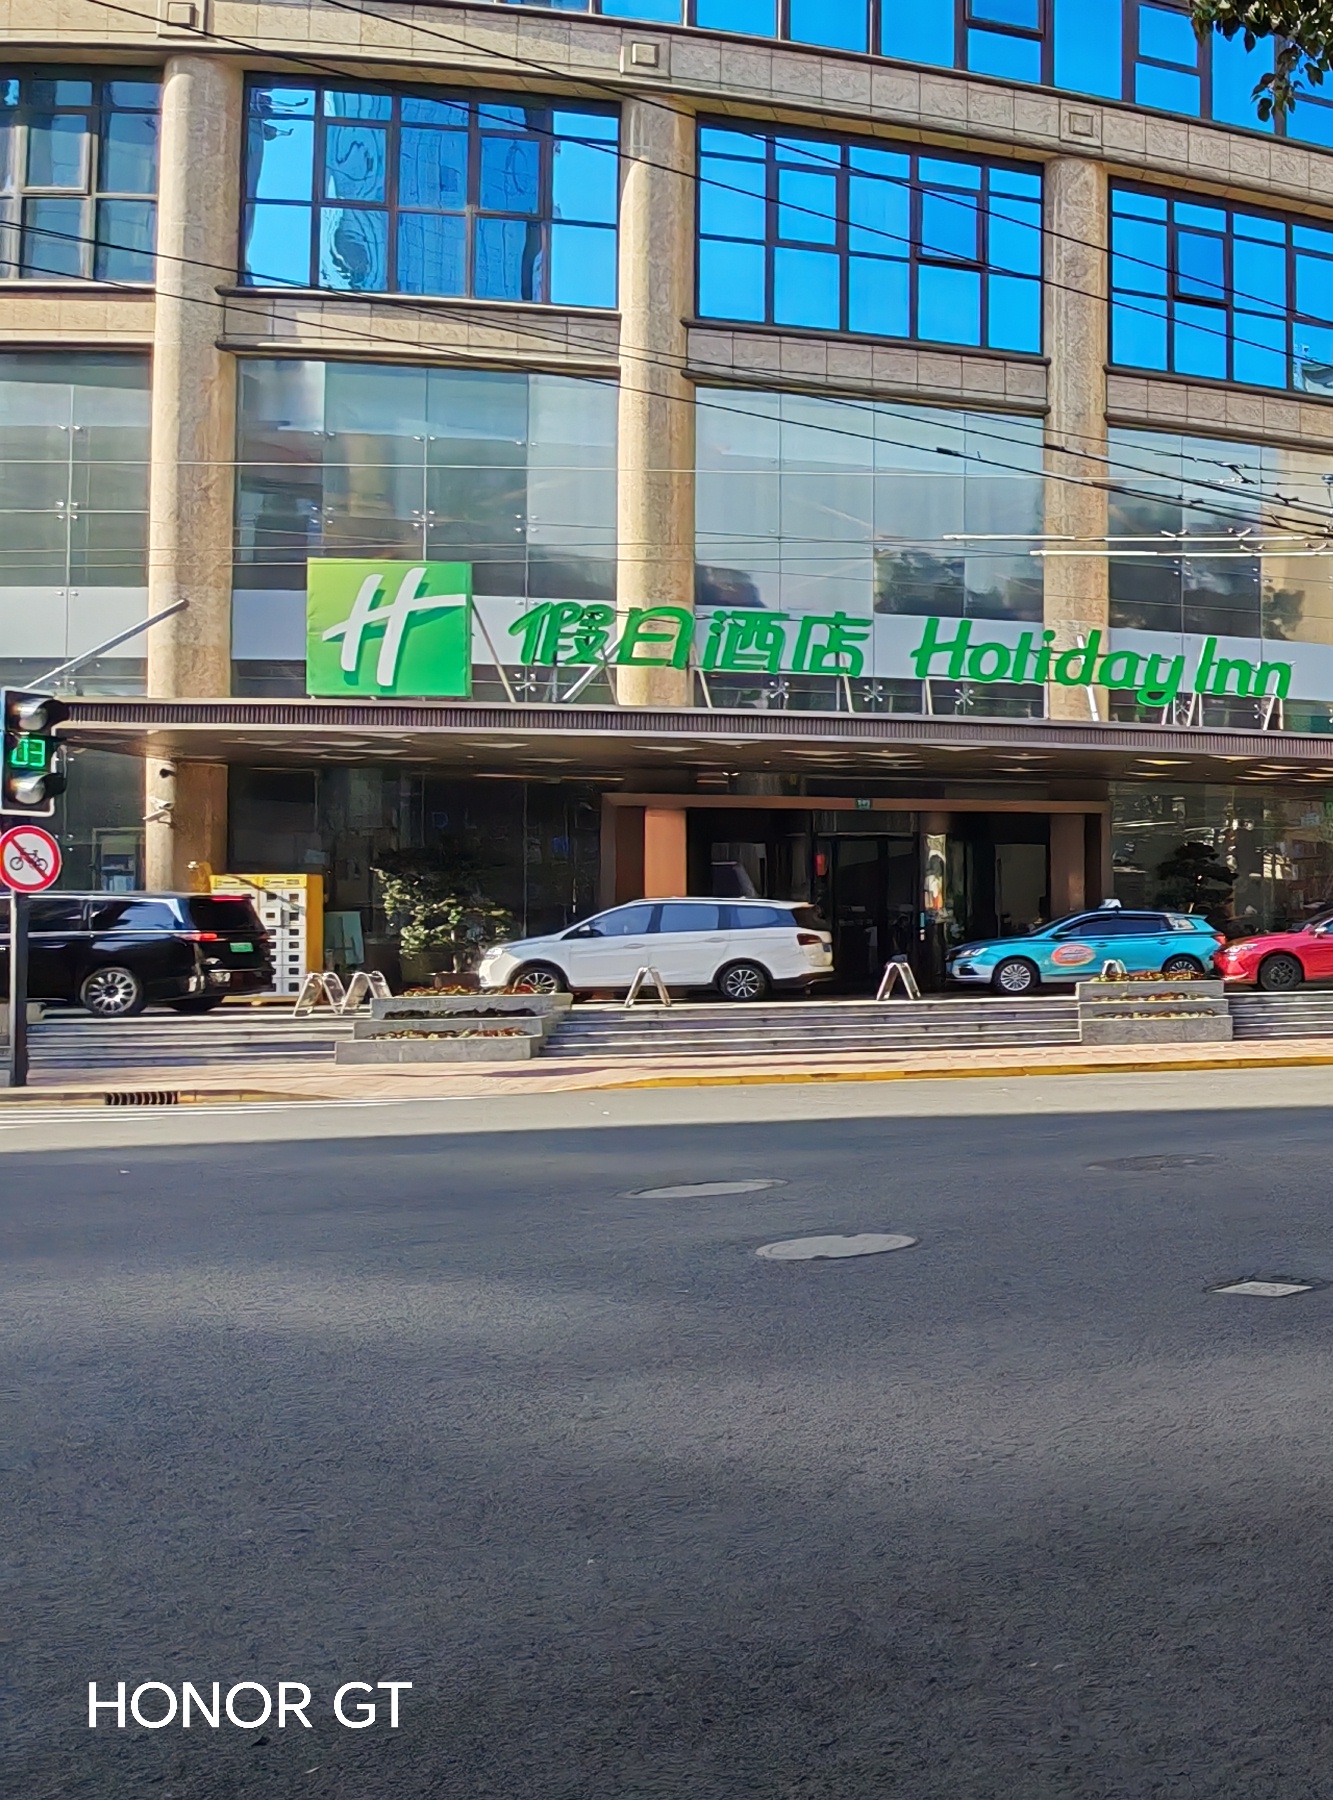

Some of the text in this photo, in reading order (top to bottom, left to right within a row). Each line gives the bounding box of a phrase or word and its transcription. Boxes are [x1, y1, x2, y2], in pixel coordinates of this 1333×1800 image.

[508, 600, 873, 678] 假日酒店
[910, 617, 1292, 707] Holiday Inn
